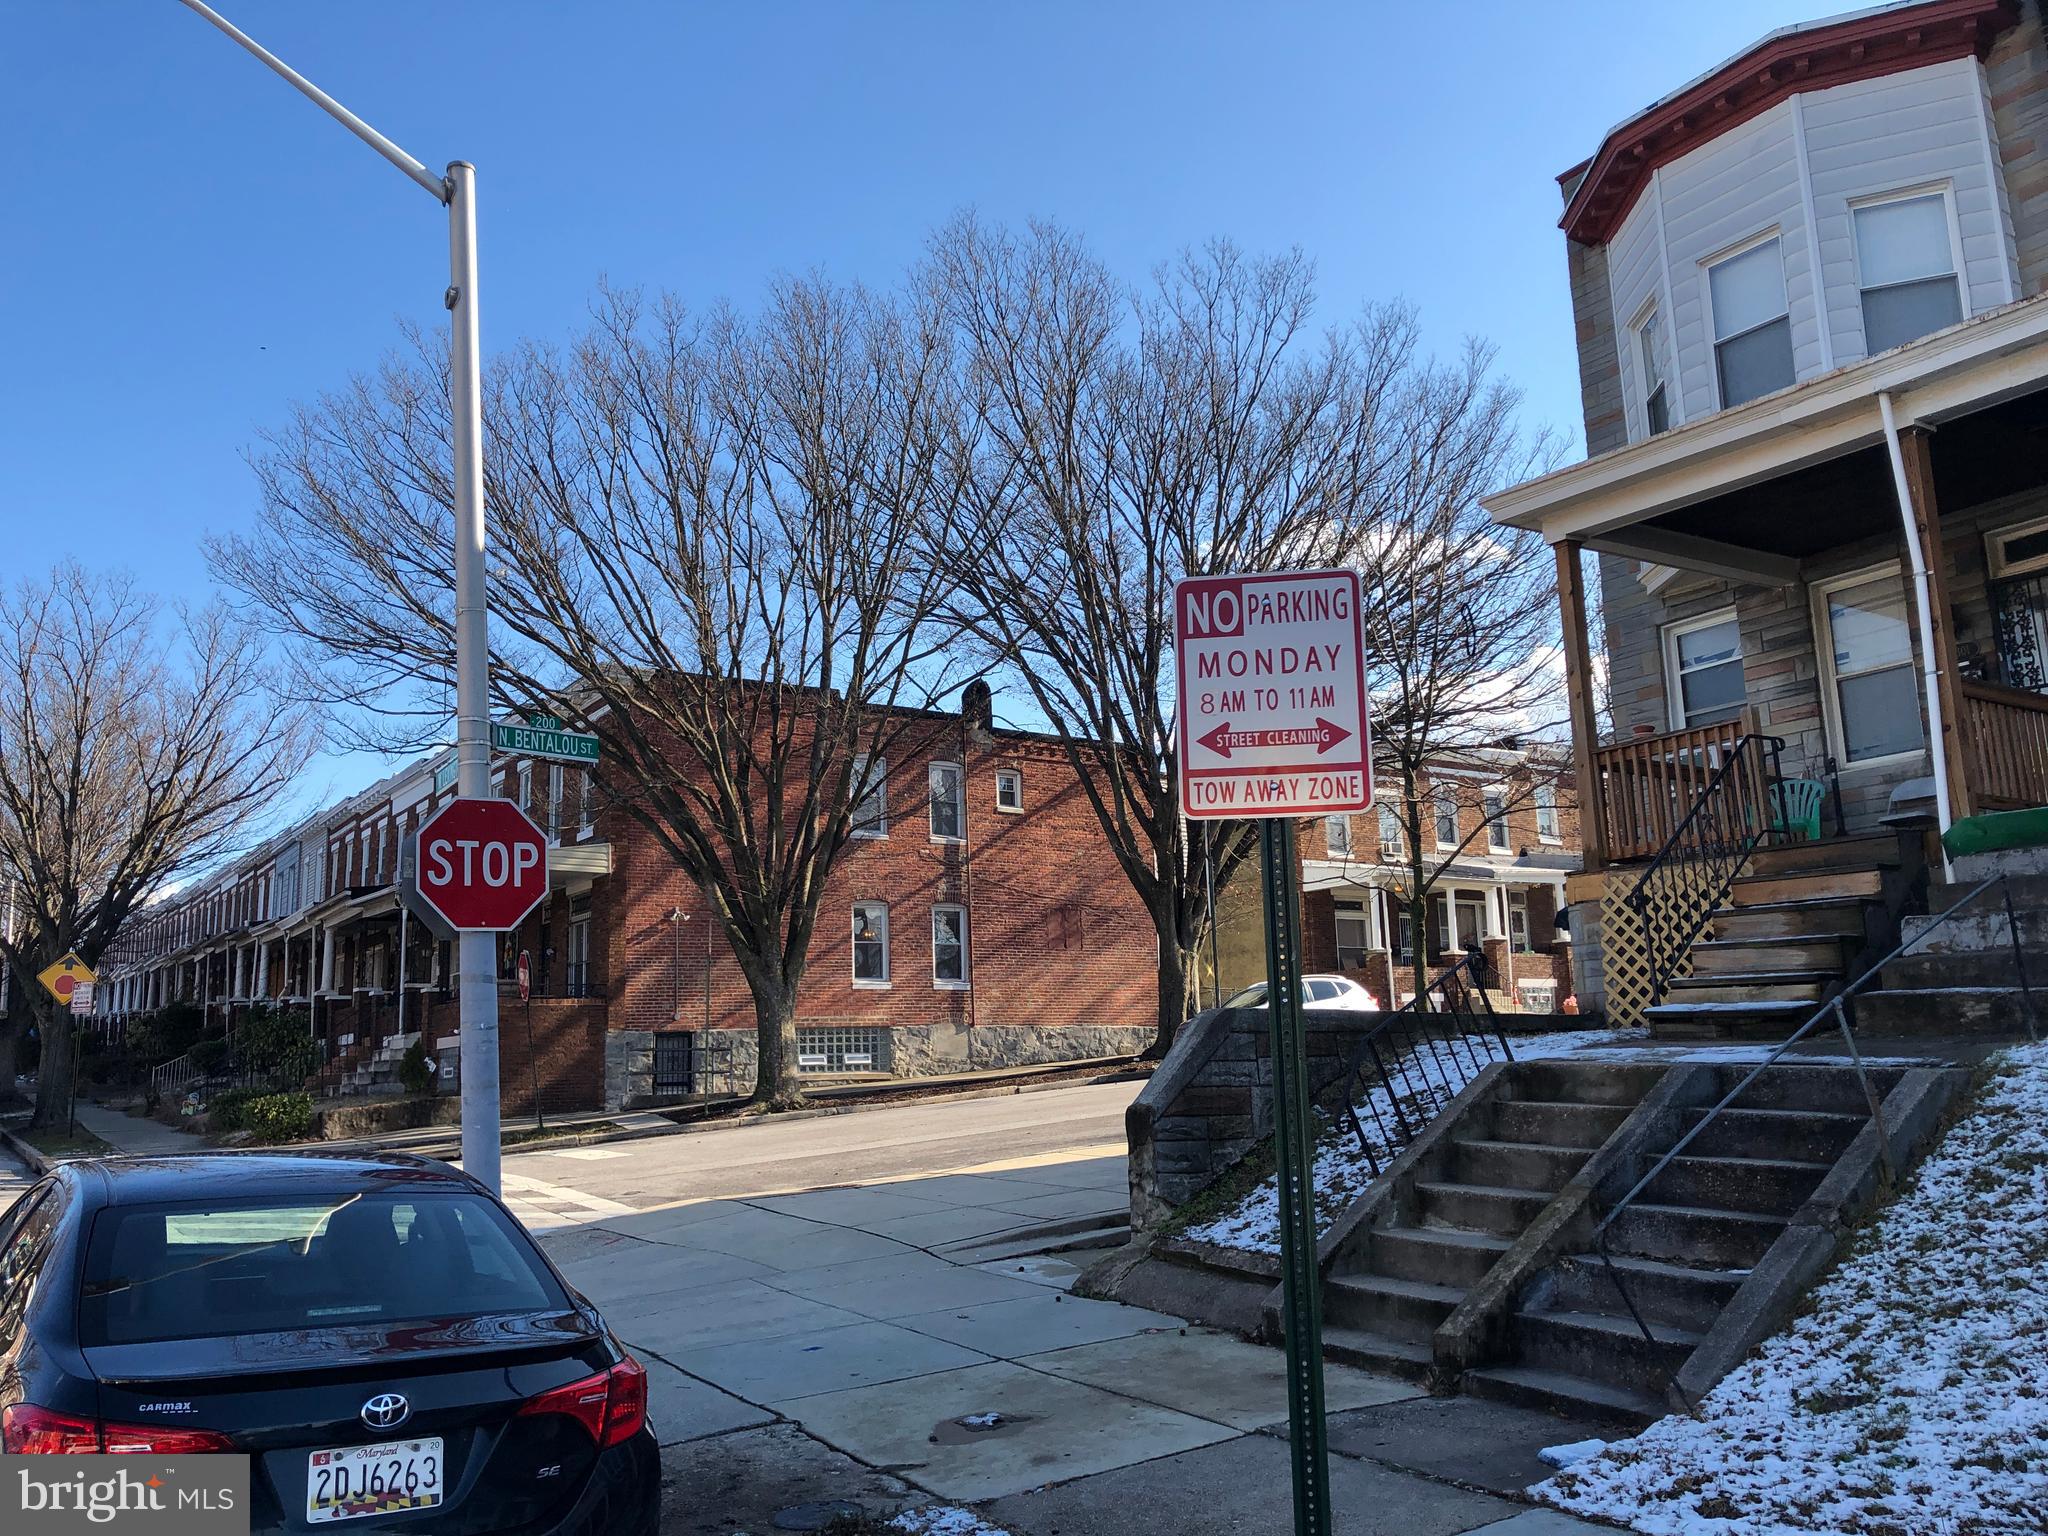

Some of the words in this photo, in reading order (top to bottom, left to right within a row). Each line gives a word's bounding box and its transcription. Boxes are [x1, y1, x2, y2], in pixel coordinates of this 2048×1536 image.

[1186, 590, 1240, 635] NO
[1248, 587, 1348, 625] PARKING
[1198, 644, 1341, 679] MONDAY
[1254, 688, 1279, 711] TO
[536, 716, 556, 729] 200
[500, 727, 511, 746] N.
[515, 730, 578, 755] BENTALOU
[1216, 732, 1260, 747] STREET
[1267, 729, 1330, 745] CLEANING
[1193, 780, 1236, 805] TOW
[1244, 778, 1300, 802] AWAY
[1308, 775, 1360, 800] ZONE
[427, 838, 539, 888] STOP
[356, 1444, 399, 1460] Maryland
[430, 1441, 440, 1450] 20
[316, 1456, 436, 1504] 2DJ6263
[536, 1465, 560, 1478] SE
